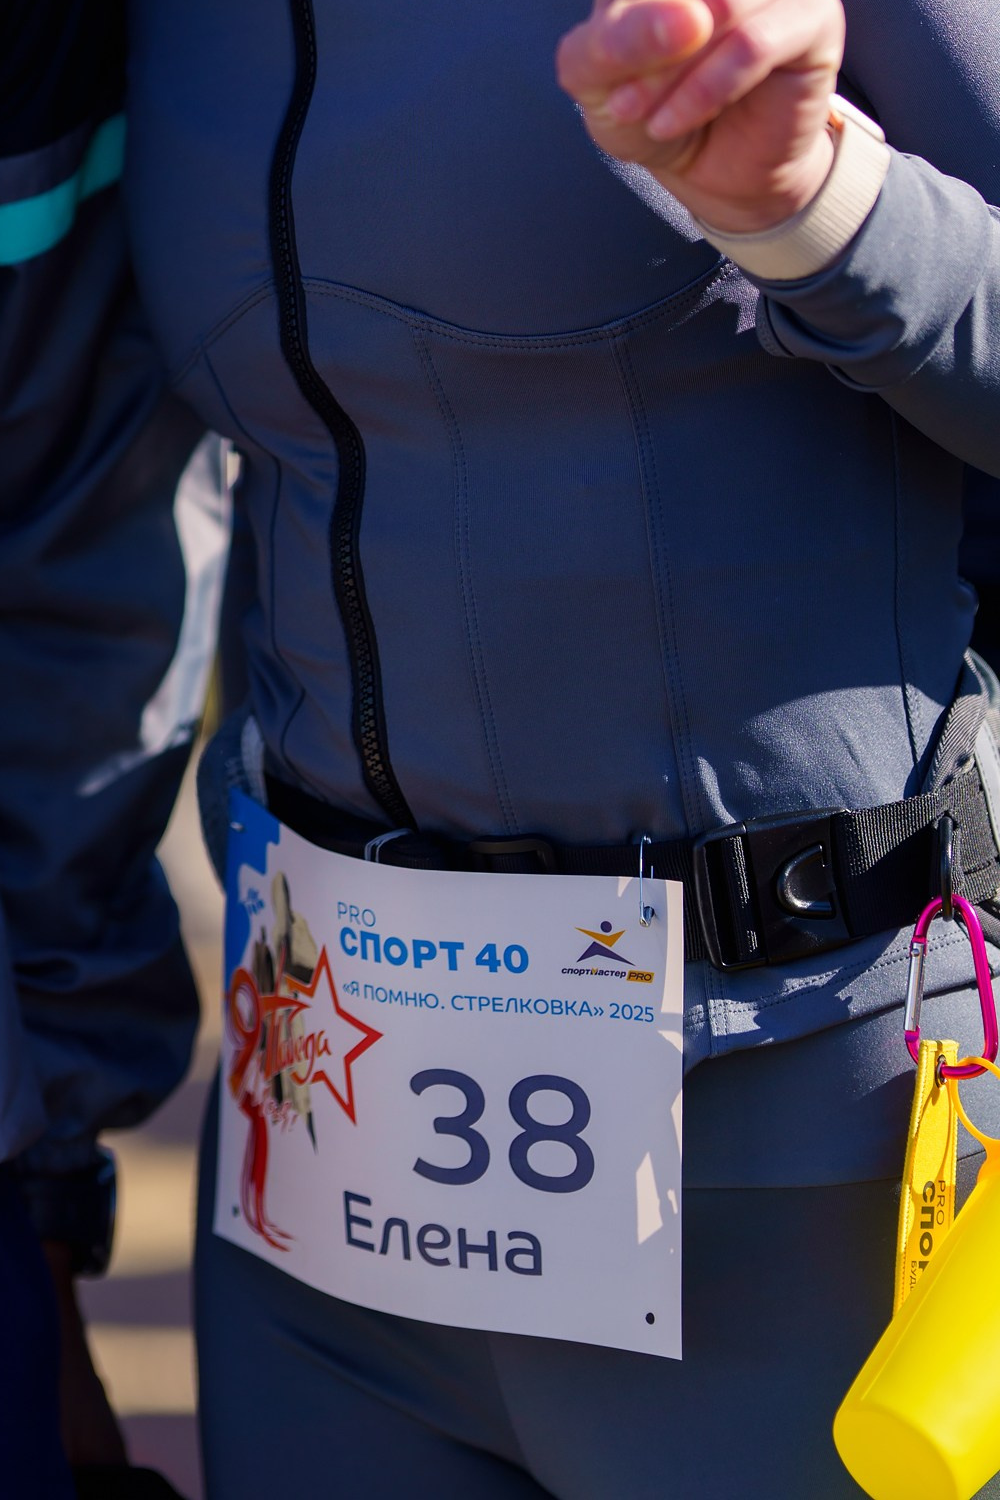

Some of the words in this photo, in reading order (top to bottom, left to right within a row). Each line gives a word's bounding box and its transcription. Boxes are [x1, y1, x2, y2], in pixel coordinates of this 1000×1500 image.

[337, 901, 376, 928] PRO
[339, 926, 465, 972] СПОРТ
[474, 943, 530, 974] 40
[628, 971, 652, 982] PRO
[342, 980, 360, 997] «Я
[363, 983, 445, 1010] ПОМНЮ.
[450, 994, 605, 1017] СТРЕЛКОВКА»
[609, 1002, 655, 1023] 2025
[409, 1067, 596, 1194] 38
[936, 1179, 946, 1225] PRO
[343, 1190, 543, 1277] Елена
